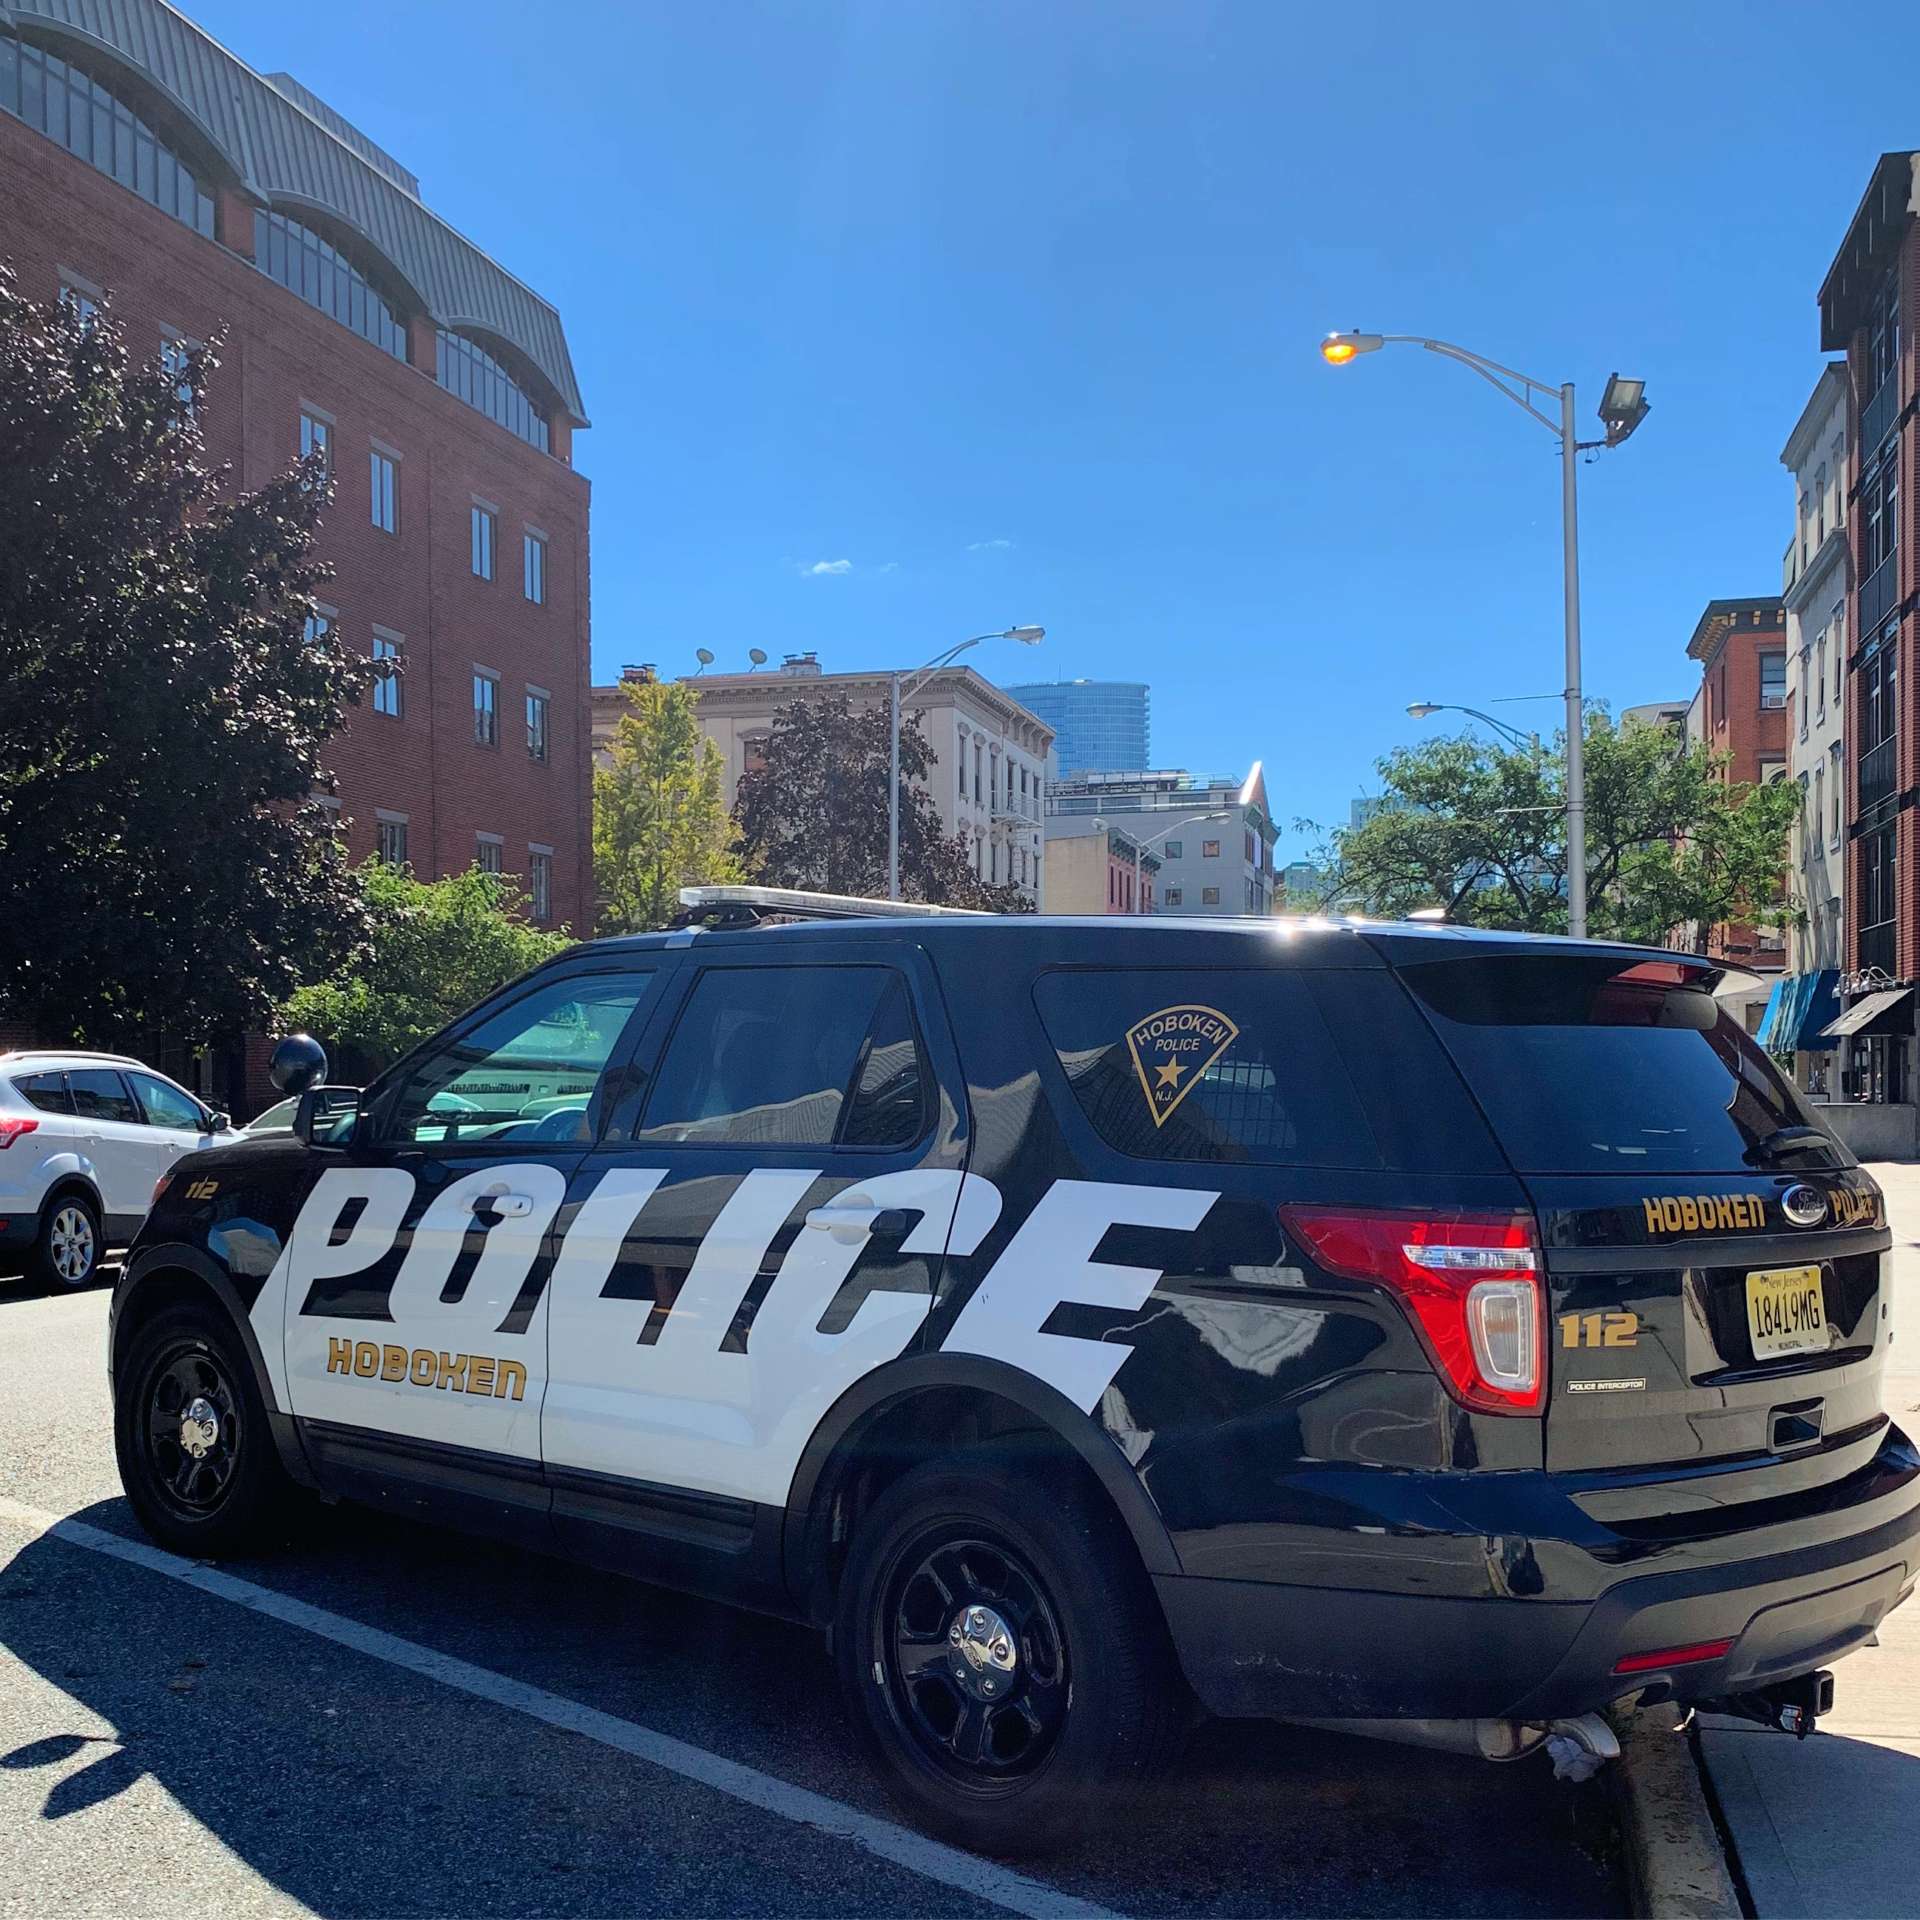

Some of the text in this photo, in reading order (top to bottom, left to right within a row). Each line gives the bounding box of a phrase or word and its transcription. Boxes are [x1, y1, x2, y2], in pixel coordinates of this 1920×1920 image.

[1136, 1013, 1228, 1046] HOBOKEN
[1155, 1038, 1201, 1051] POLICE
[185, 1181, 219, 1199] 112
[1643, 1194, 1766, 1233] HOBOKEN
[249, 1163, 1222, 1416] POLICE
[1559, 1313, 1638, 1348] 112
[1754, 1289, 1820, 1338] 18419MG
[327, 1337, 527, 1401] HOBOKEN
[1569, 1381, 1643, 1391] POLICE INTERCEPTOR
